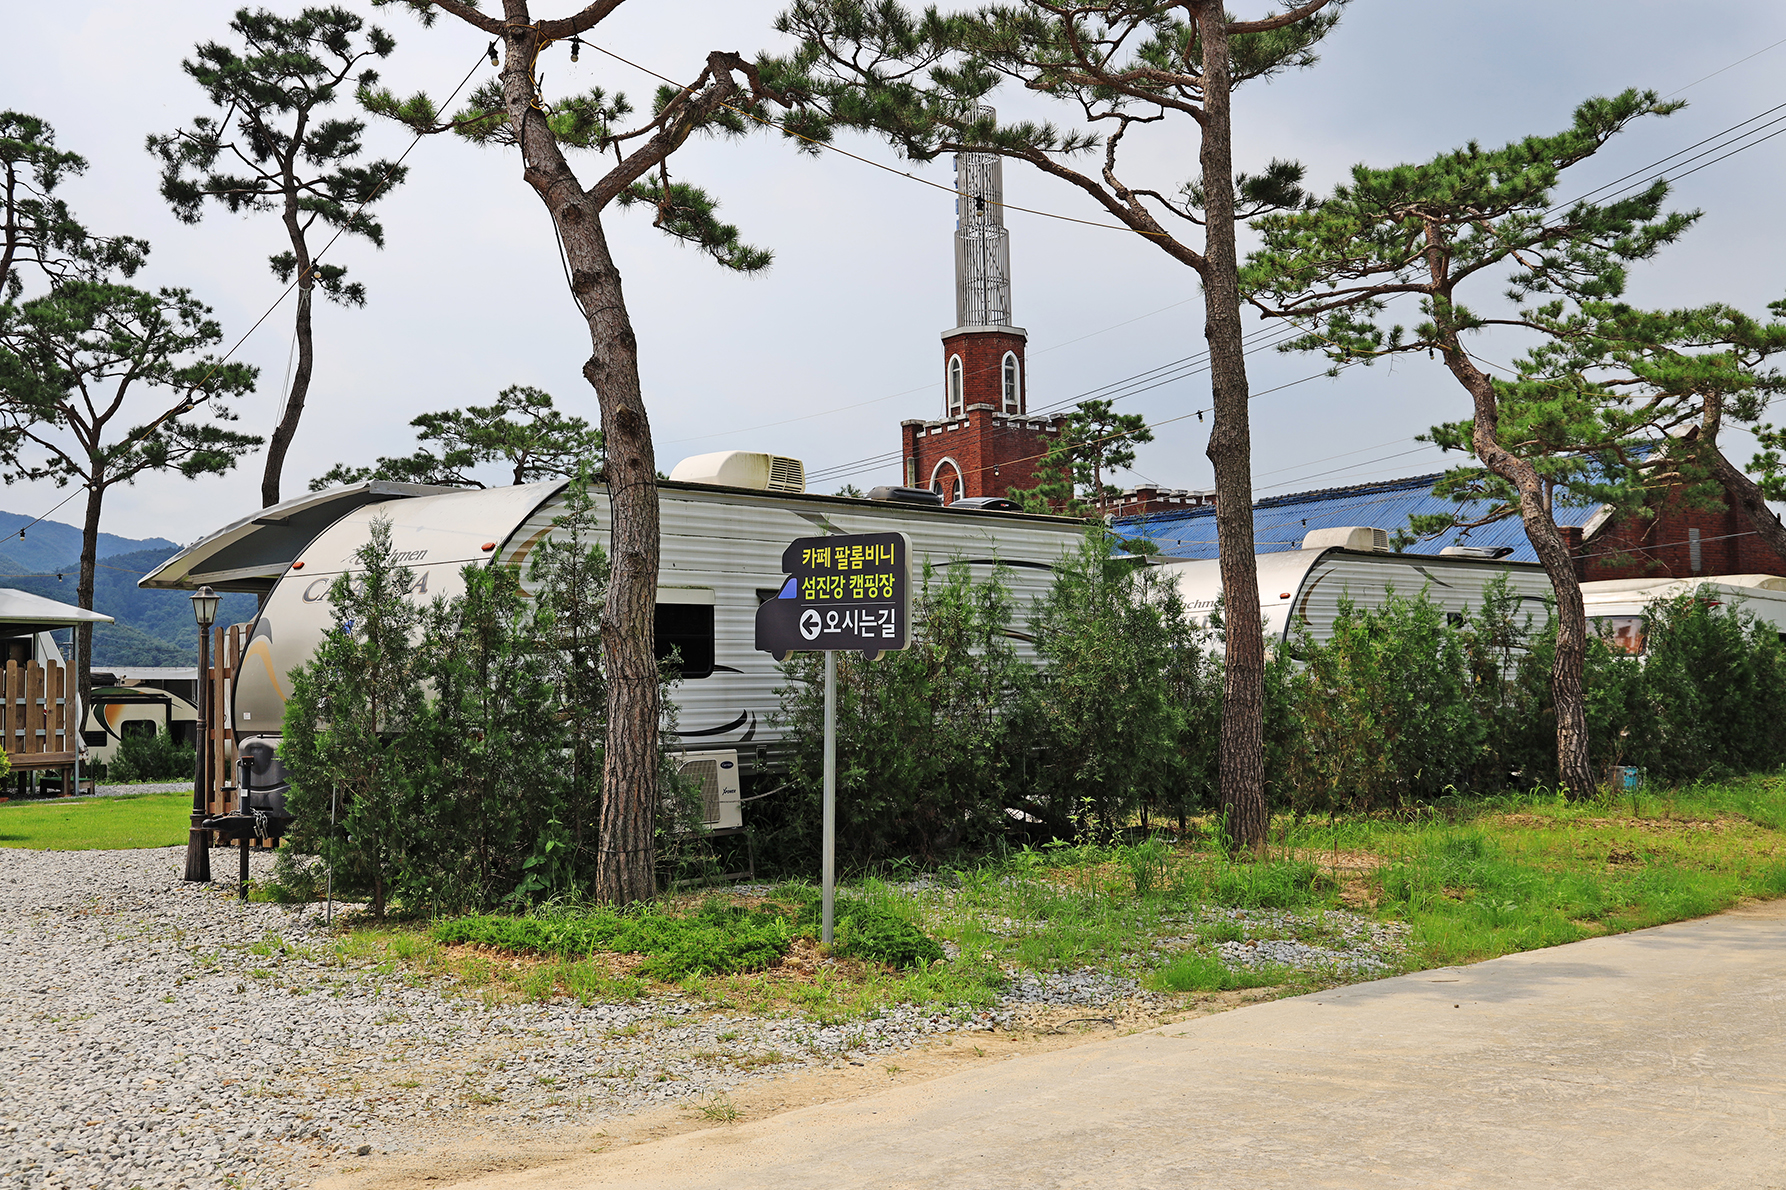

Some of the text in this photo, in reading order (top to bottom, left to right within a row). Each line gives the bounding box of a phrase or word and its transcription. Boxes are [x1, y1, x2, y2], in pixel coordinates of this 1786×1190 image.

[802, 543, 895, 571] 카페 팔롬비니
[801, 572, 896, 600] 섬진강 캠핑장
[823, 608, 896, 639] 오시는길
